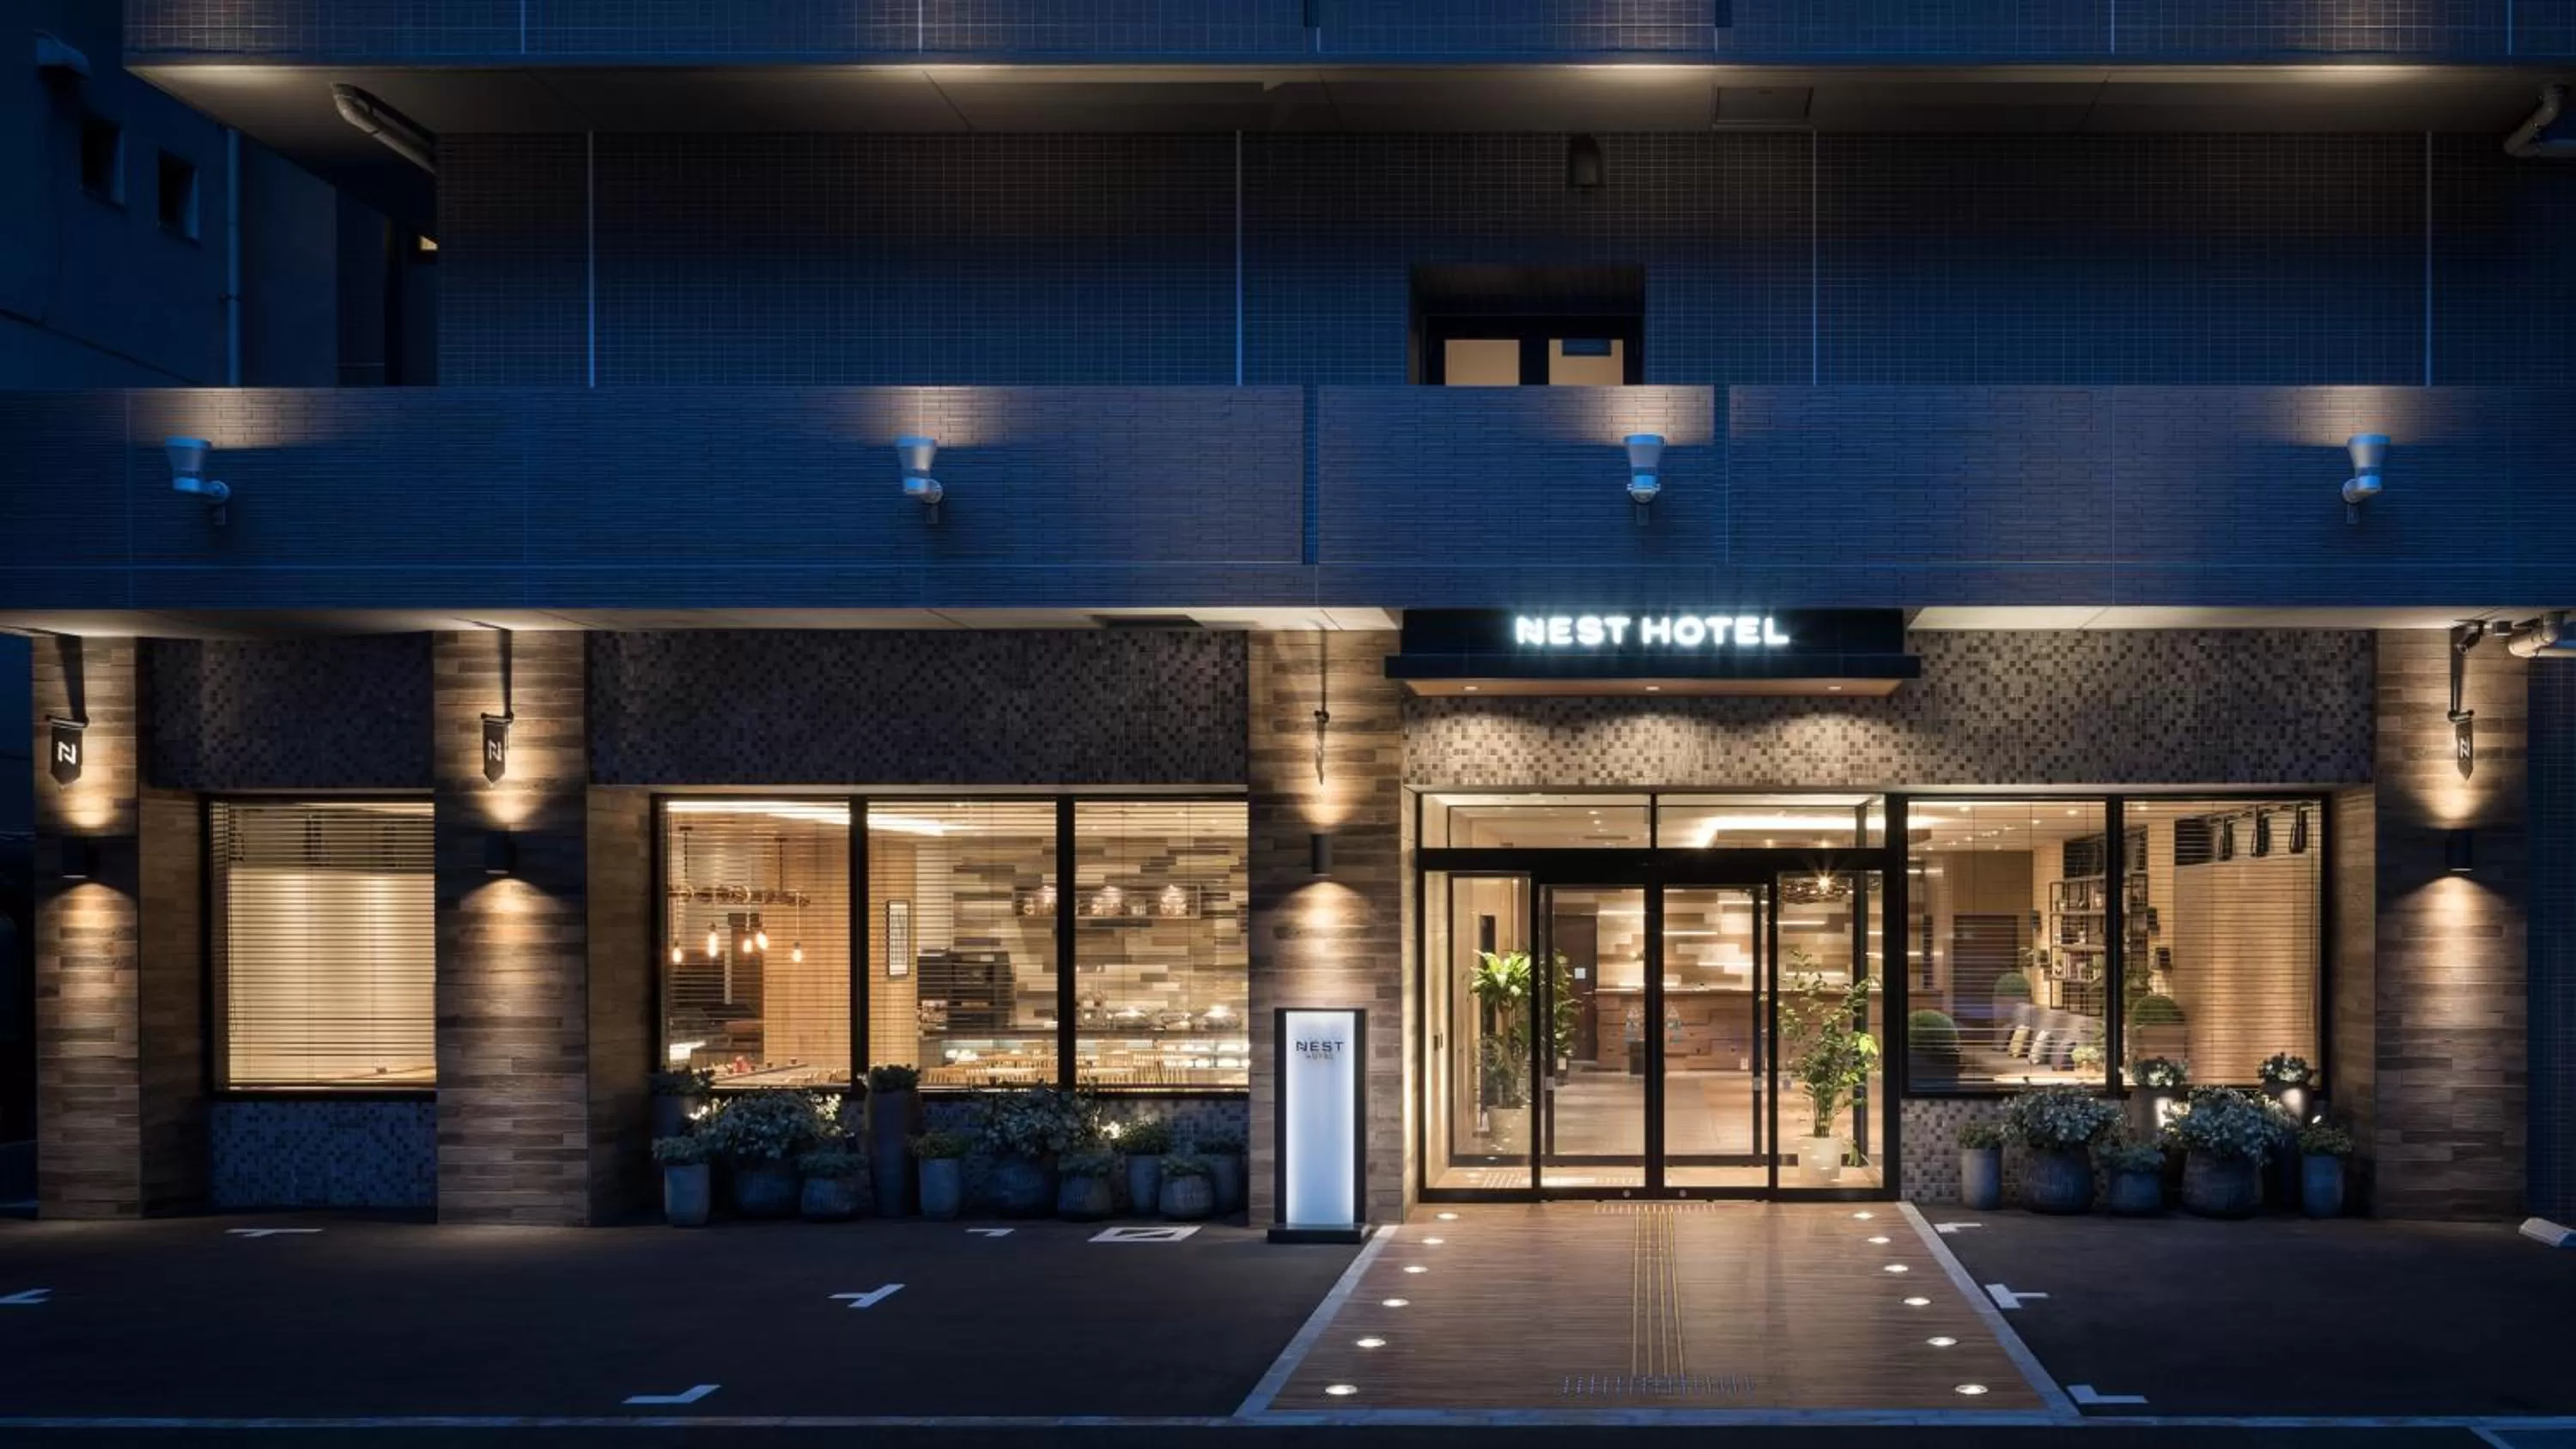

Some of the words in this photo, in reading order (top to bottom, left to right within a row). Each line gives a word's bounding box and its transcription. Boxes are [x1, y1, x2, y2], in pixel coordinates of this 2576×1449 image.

[1515, 615, 1631, 646] NEST
[1641, 616, 1789, 646] HOTEL
[1296, 1040, 1344, 1052] NEST
